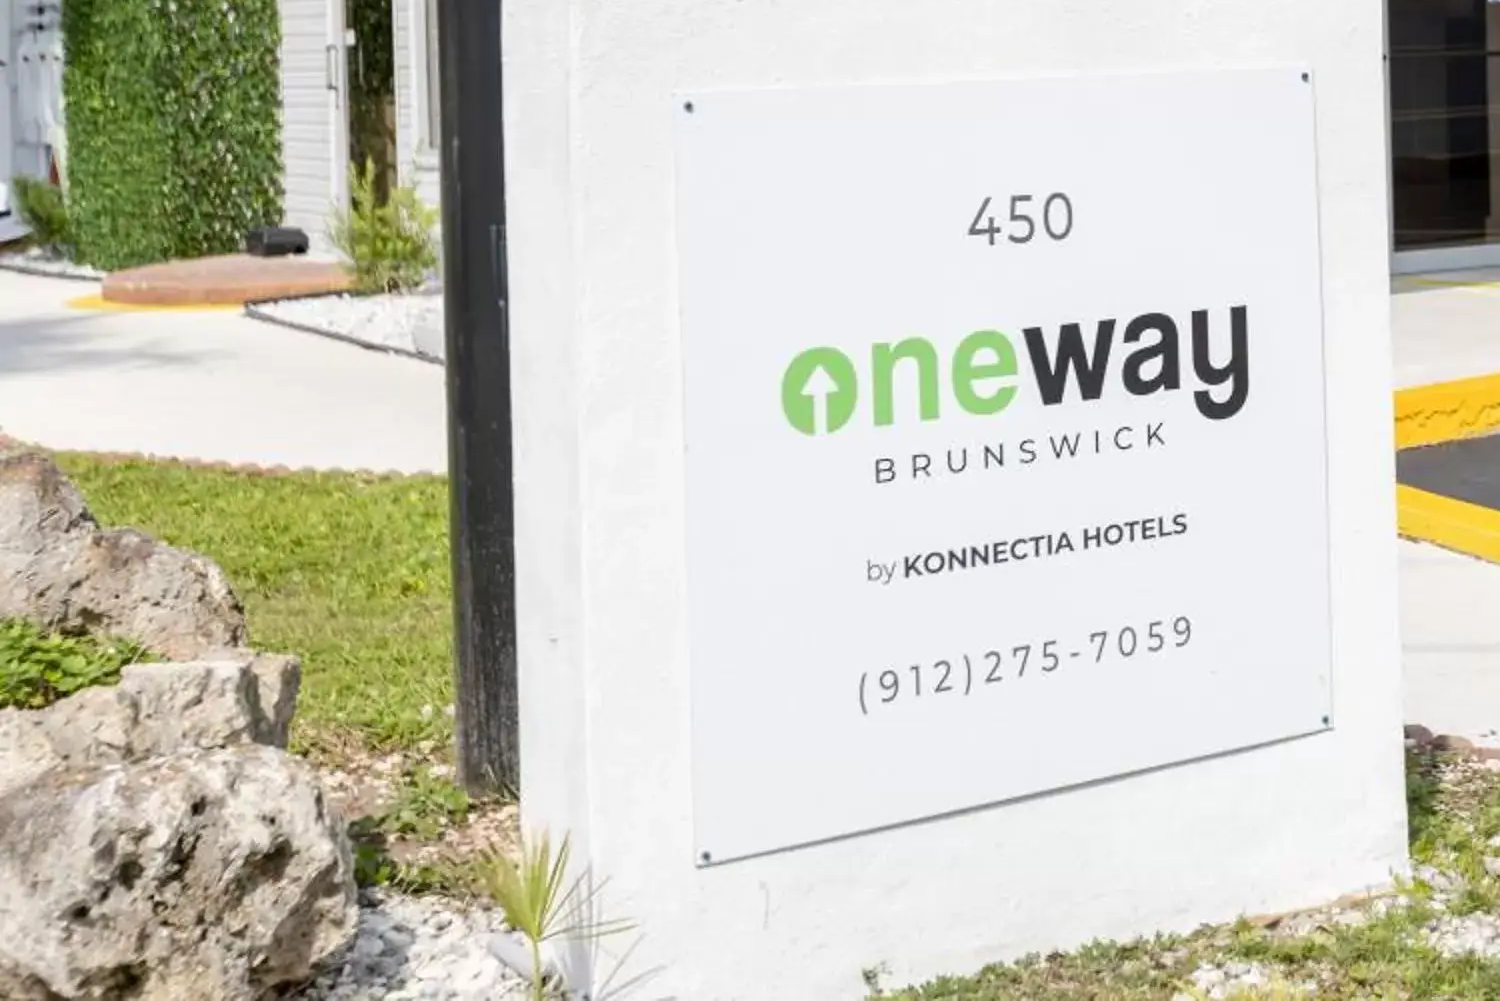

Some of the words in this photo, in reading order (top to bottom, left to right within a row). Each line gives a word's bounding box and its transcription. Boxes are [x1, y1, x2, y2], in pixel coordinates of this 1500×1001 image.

[967, 192, 1074, 245] 450
[781, 304, 1250, 436] oneway
[873, 422, 1167, 484] BRUNSWICK
[866, 558, 897, 585] by
[903, 532, 1075, 579] KONNECTIA
[1082, 513, 1189, 550] HOTELS
[858, 615, 1194, 716] (912)275-7059
